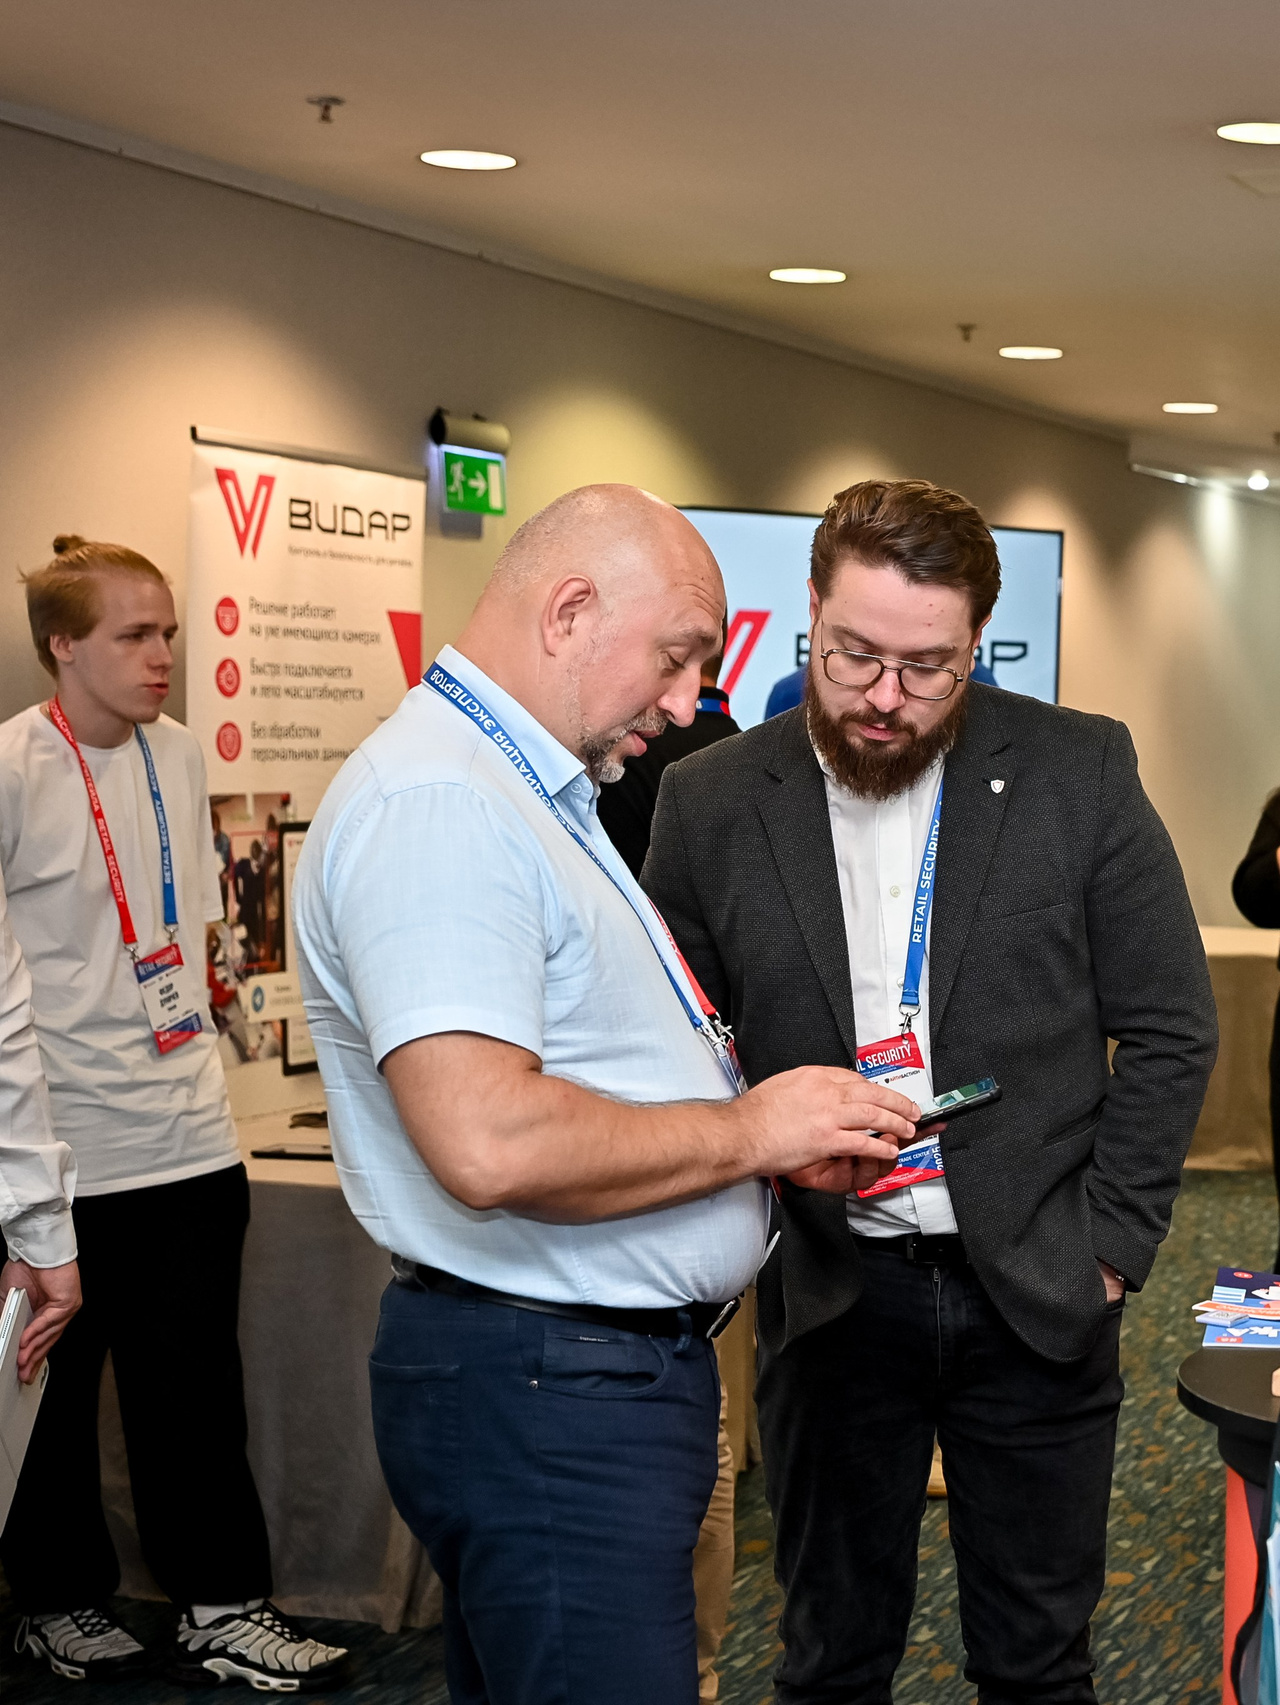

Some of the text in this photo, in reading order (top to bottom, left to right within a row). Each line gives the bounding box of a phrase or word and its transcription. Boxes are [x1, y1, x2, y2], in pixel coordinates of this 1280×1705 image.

[430, 668, 497, 732] ЭКСПЕРТОВ
[97, 817, 125, 903] RETAIL SECURITY
[156, 800, 172, 884] RETAIL SECURITY
[912, 818, 941, 944] RETAIL SECURITY
[865, 1043, 912, 1069] SECURITY
